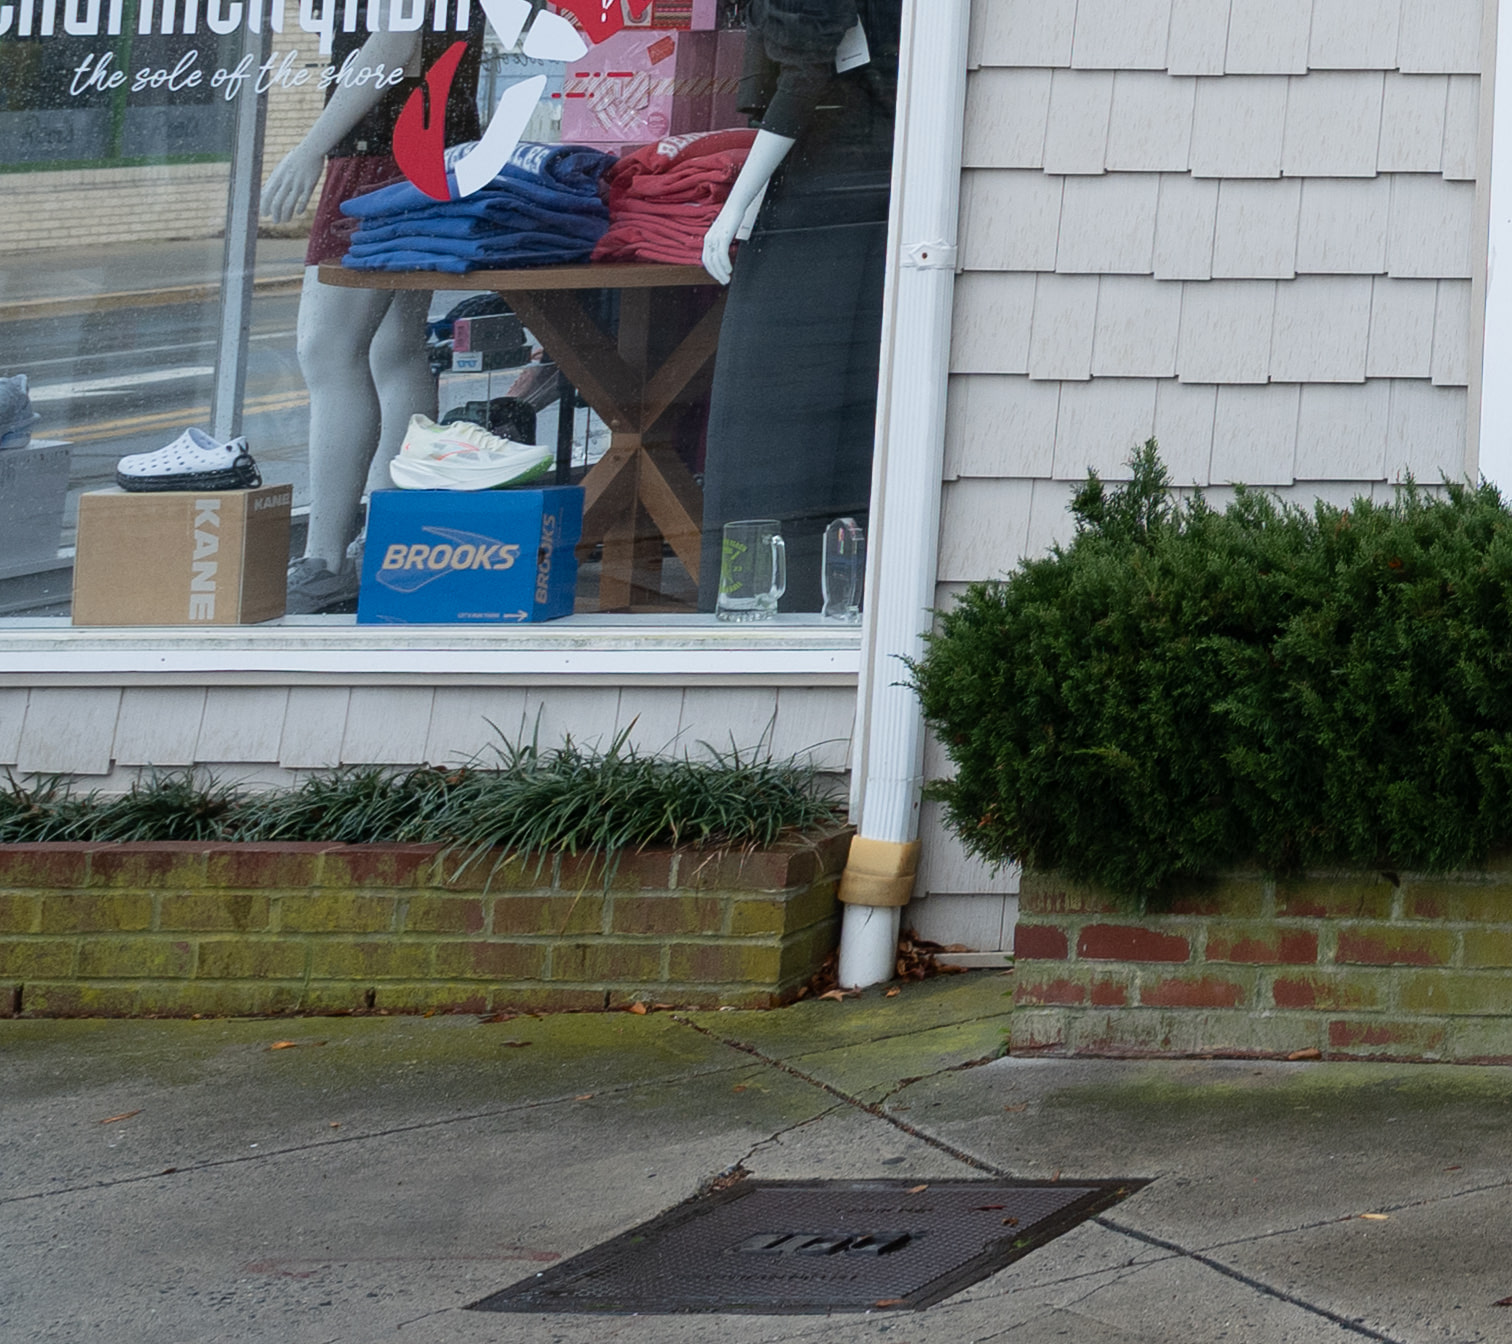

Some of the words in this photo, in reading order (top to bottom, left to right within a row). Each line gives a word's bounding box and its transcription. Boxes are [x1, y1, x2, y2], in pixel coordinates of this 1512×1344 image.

[70, 50, 127, 96] the
[132, 50, 203, 92] sole
[210, 53, 254, 102] of
[255, 50, 311, 97] the
[317, 48, 405, 91] shore
[254, 492, 291, 511] KANE
[188, 499, 221, 620] KANE
[381, 543, 520, 571] BROOKS
